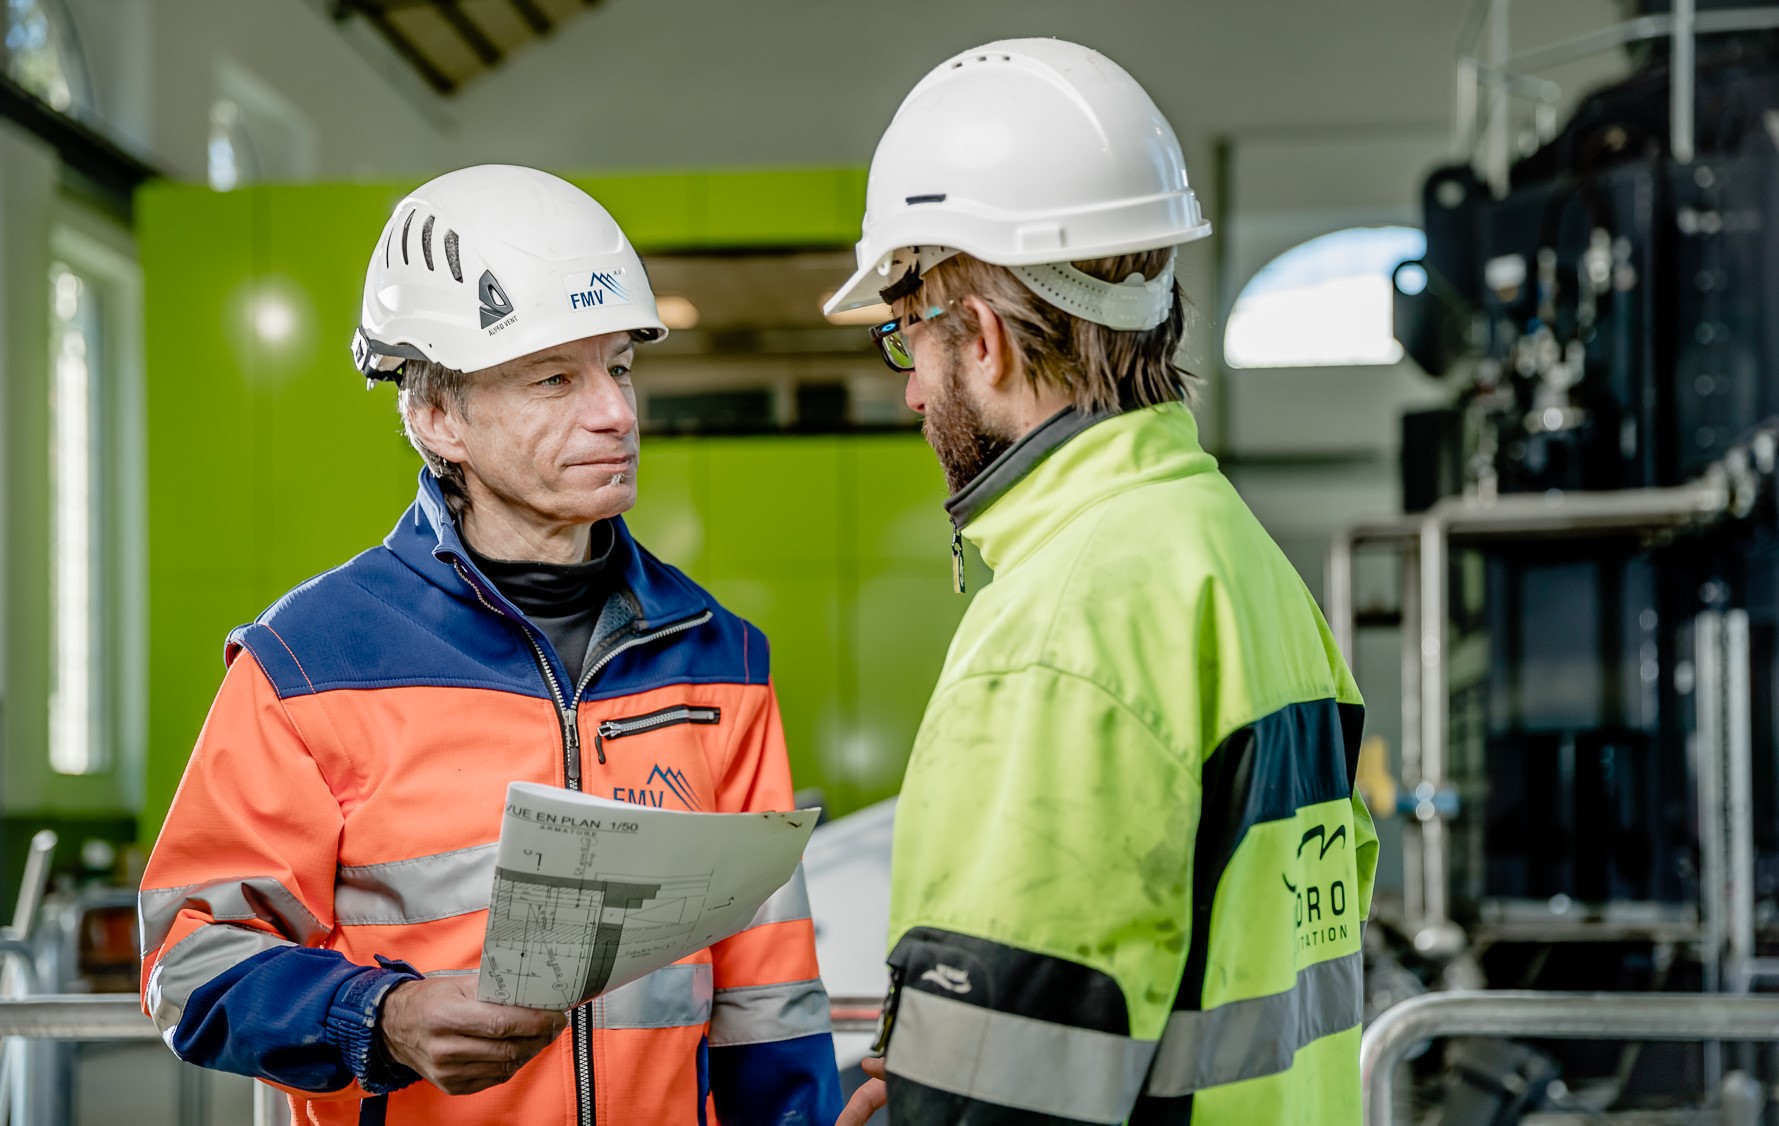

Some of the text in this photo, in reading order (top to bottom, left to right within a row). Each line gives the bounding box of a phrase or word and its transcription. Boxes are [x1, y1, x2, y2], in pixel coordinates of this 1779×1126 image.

[570, 289, 604, 310] FMV
[503, 315, 518, 327] VENT
[613, 787, 664, 809] FMV
[536, 812, 557, 823] EN
[561, 816, 601, 829] PLAN
[610, 821, 639, 832] 1/50
[539, 825, 597, 837] ARMATURE
